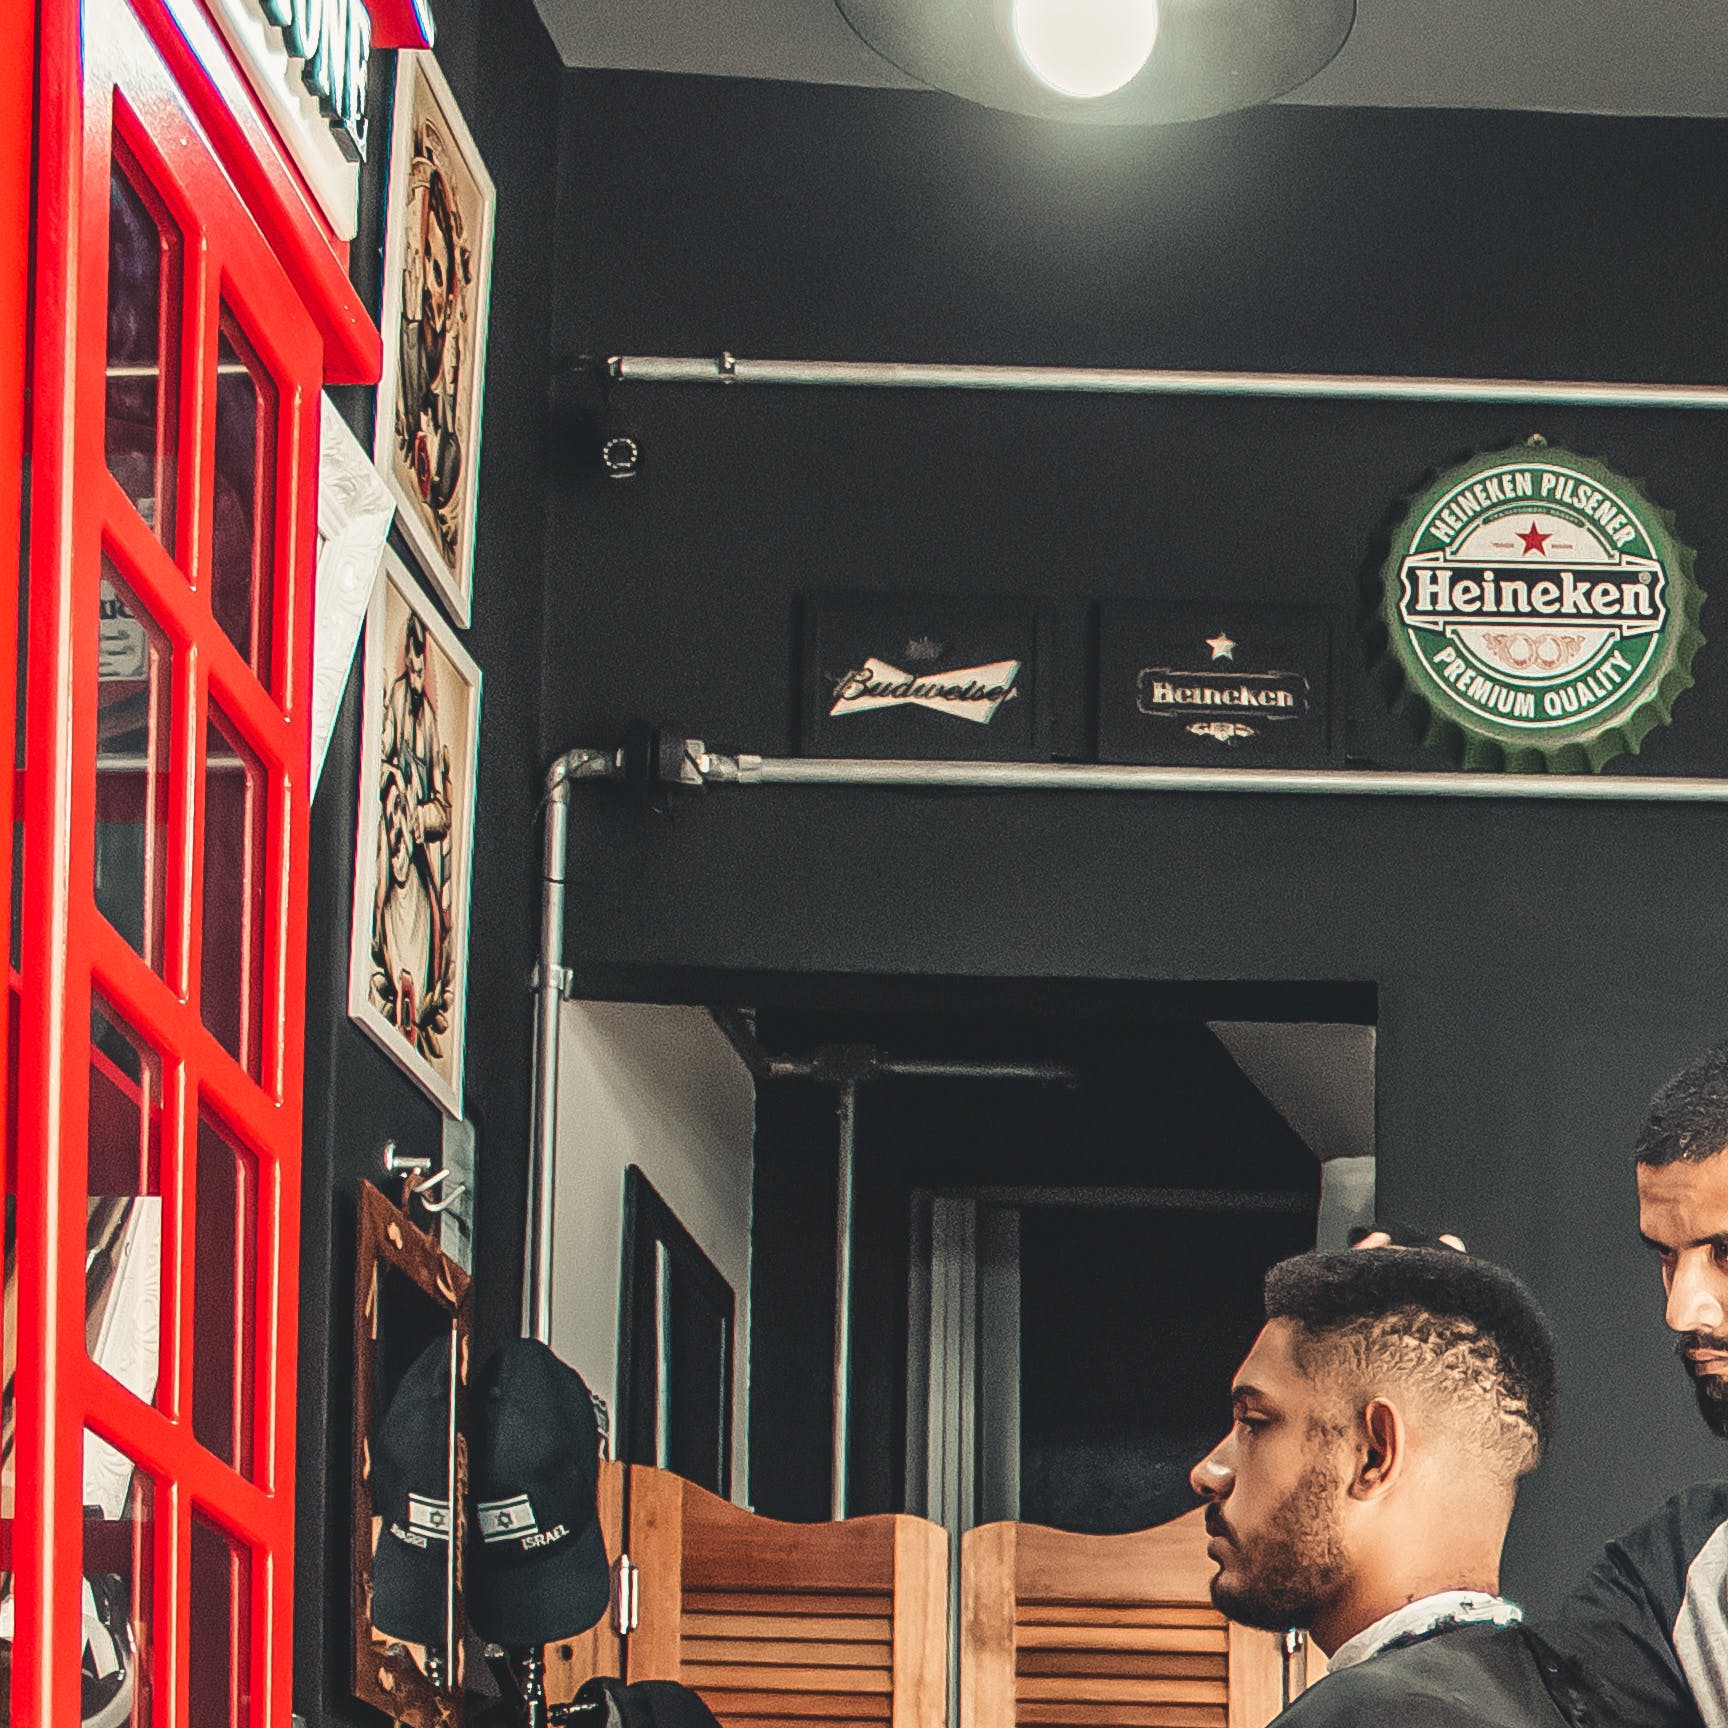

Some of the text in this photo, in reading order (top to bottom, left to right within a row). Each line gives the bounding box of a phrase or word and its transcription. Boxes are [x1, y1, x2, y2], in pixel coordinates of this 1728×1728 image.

[1429, 472, 1636, 547] HEINEKEN PILSENER
[1415, 569, 1653, 615] Heineken
[1152, 680, 1294, 708] Heineken
[1433, 646, 1632, 718] PREMIUM QUALITY
[521, 1523, 570, 1551] ISRAEL
